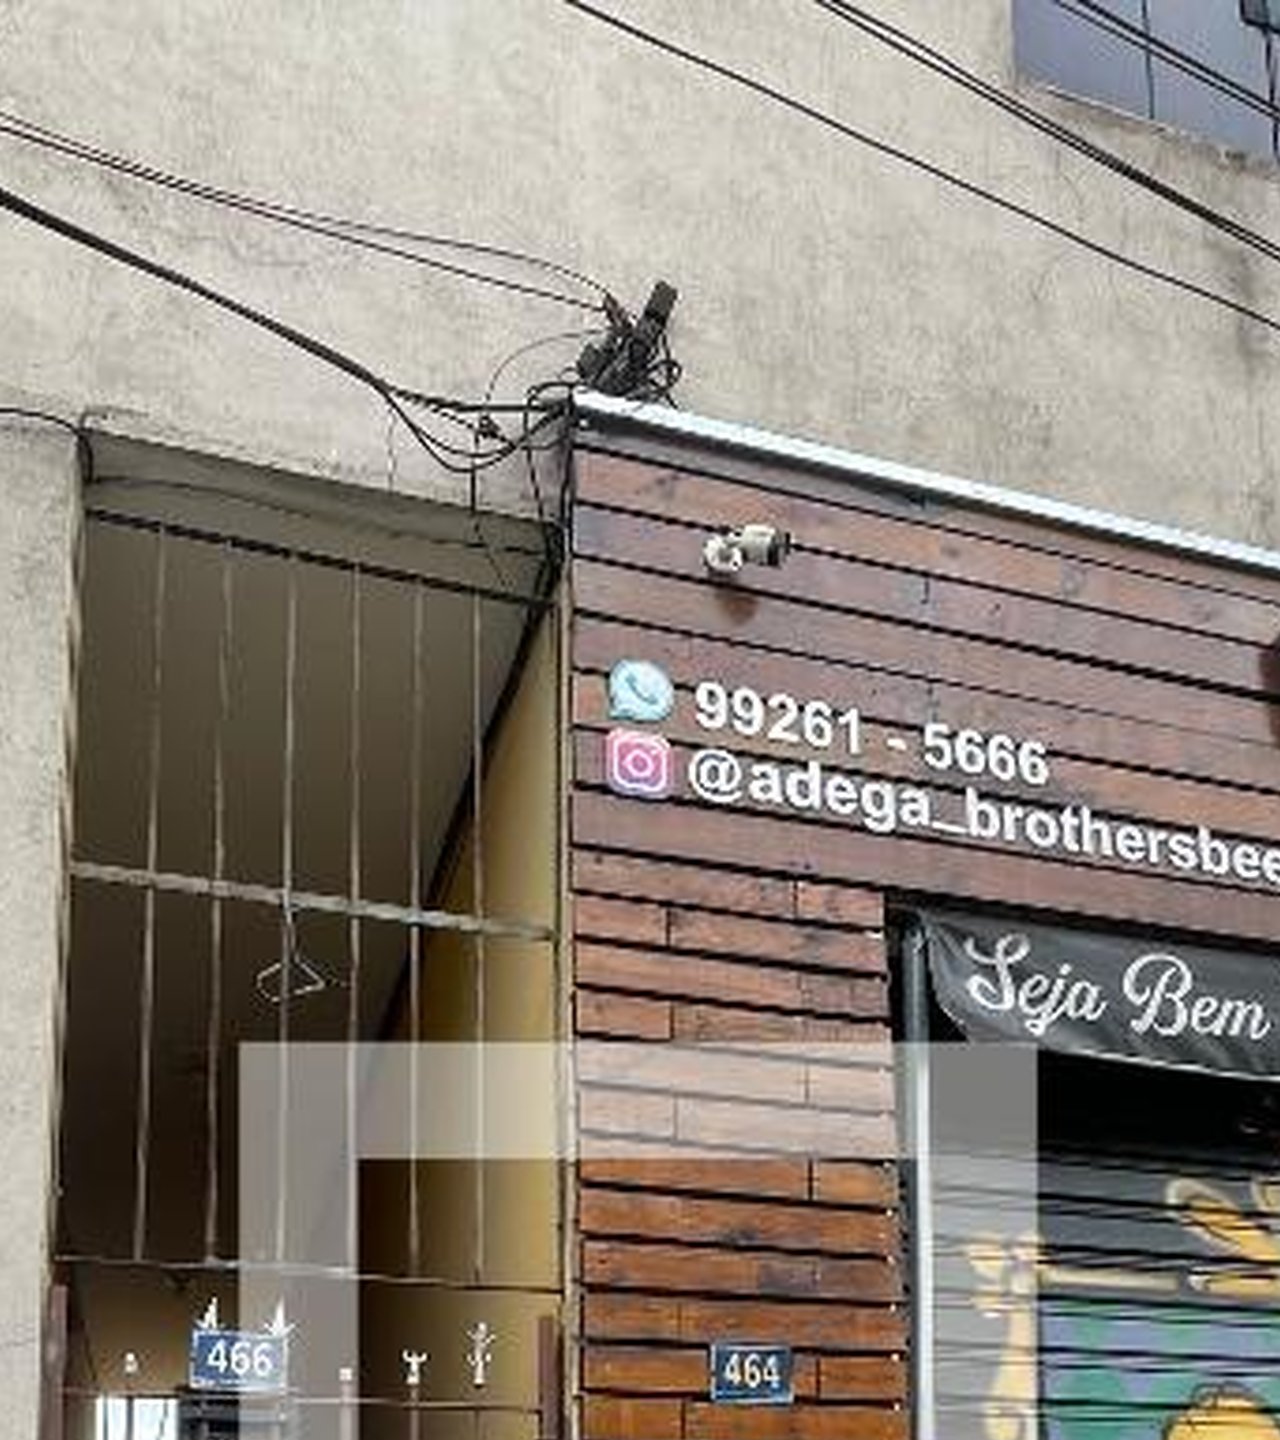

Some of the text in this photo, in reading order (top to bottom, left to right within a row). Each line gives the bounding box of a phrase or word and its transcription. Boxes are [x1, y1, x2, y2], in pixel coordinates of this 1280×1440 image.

[694, 681, 863, 756] 99261
[923, 721, 1050, 787] 5666
[964, 931, 1107, 1035] Seja
[1122, 951, 1272, 1041] Bem
[207, 1338, 274, 1377] 466
[723, 1352, 781, 1389] 464
